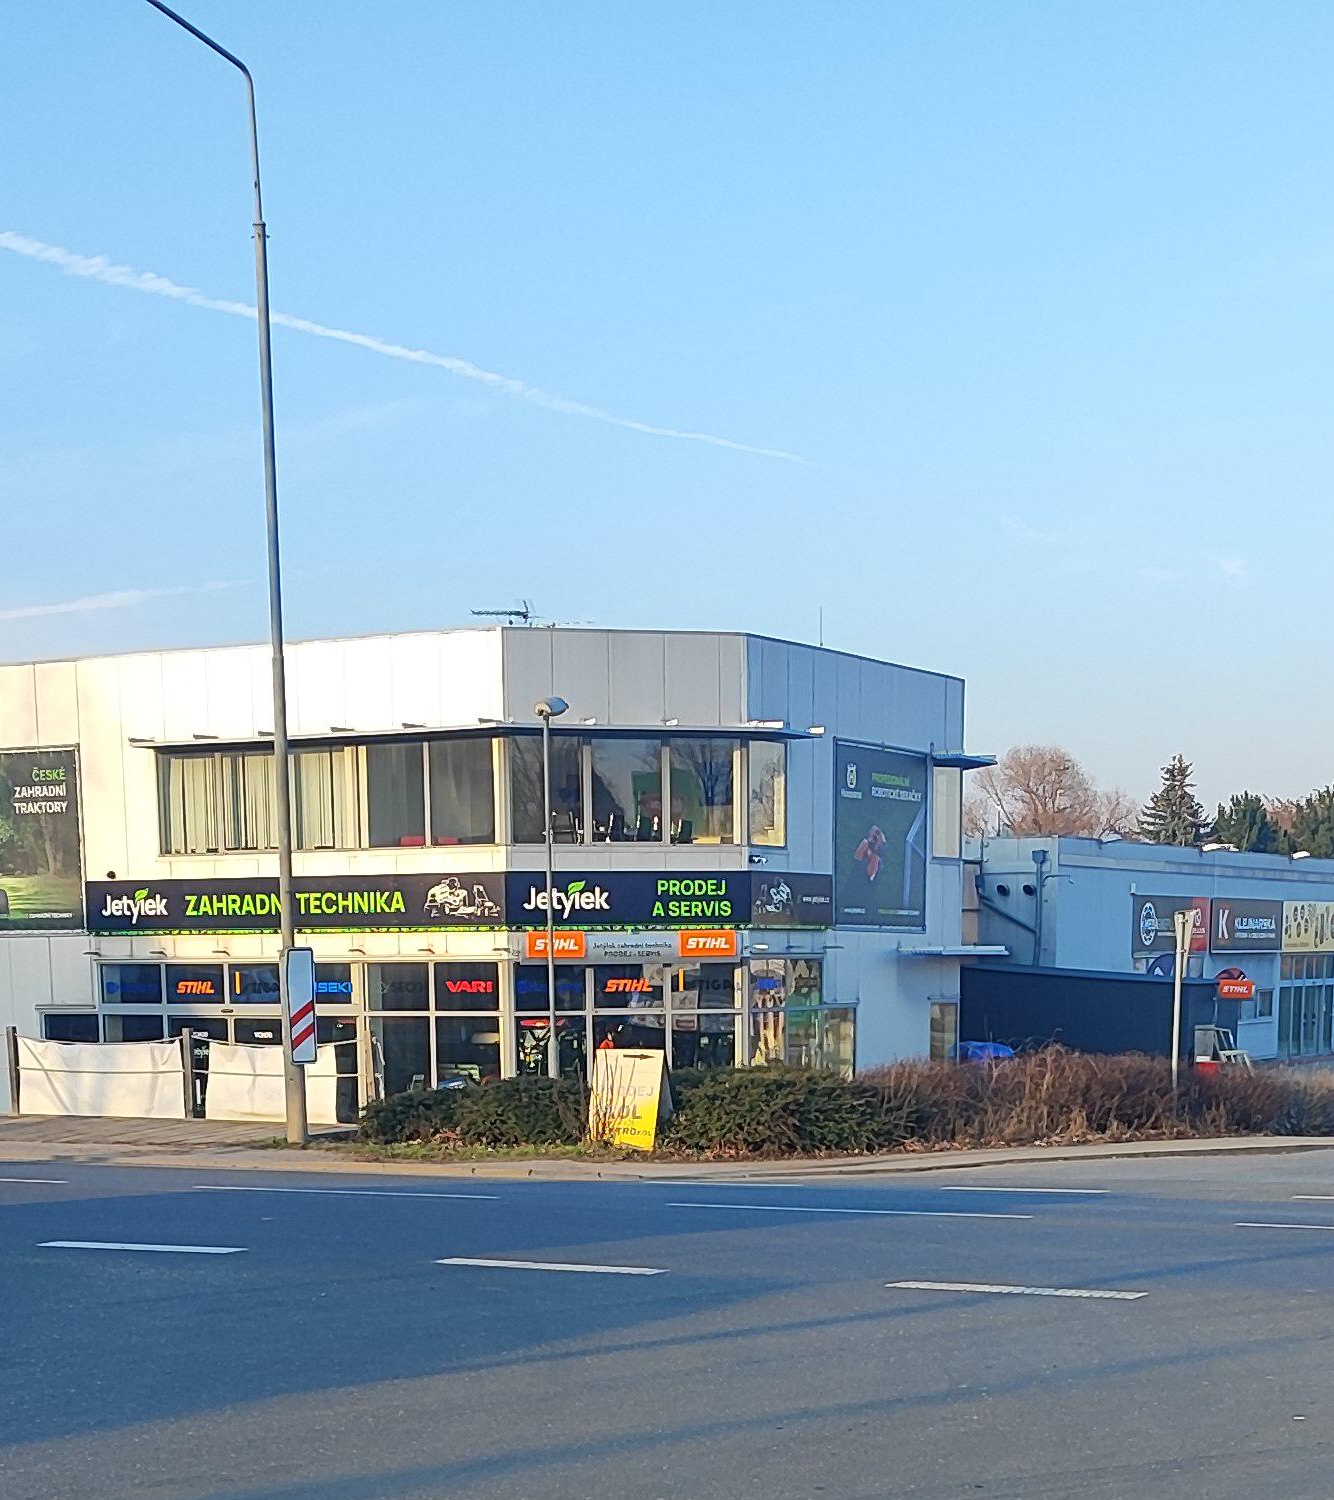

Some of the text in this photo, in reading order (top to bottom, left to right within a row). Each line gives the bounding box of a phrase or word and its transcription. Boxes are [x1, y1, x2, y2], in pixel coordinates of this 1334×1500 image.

[31, 766, 66, 782] ČESKÉ
[13, 783, 67, 799] ZAHRADNÍ
[13, 800, 68, 815] TRAKTORY
[657, 878, 727, 897] PRODEJ
[184, 894, 282, 917] ZAHRADN
[295, 890, 406, 914] TECHNIKA
[651, 901, 733, 917] A SERVIS
[685, 936, 731, 949] STIHL
[176, 980, 215, 995] STIHL
[445, 980, 494, 994] VARI
[603, 977, 654, 994] STIHL
